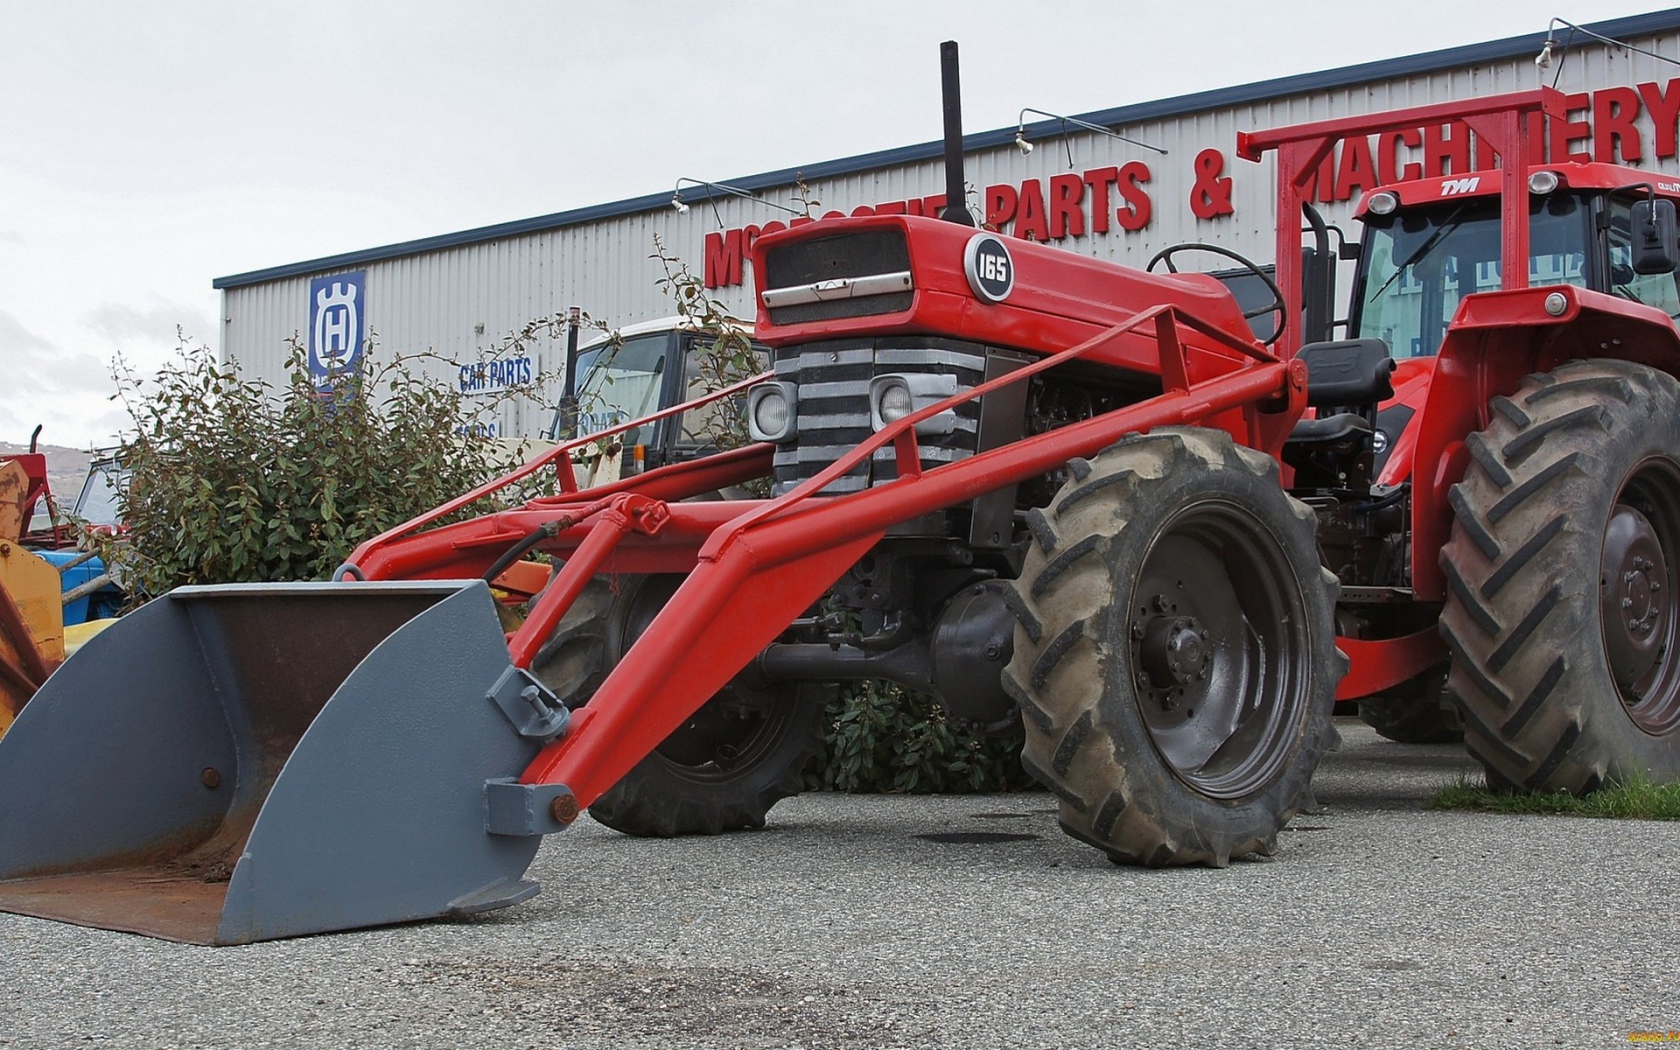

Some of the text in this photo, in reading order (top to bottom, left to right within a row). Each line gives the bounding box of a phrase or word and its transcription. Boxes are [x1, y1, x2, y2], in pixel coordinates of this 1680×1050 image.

[985, 160, 1150, 241] PARTS
[1190, 148, 1234, 220] &
[1441, 176, 1480, 196] TYM
[980, 253, 1007, 282] 165
[489, 357, 531, 388] PARTS
